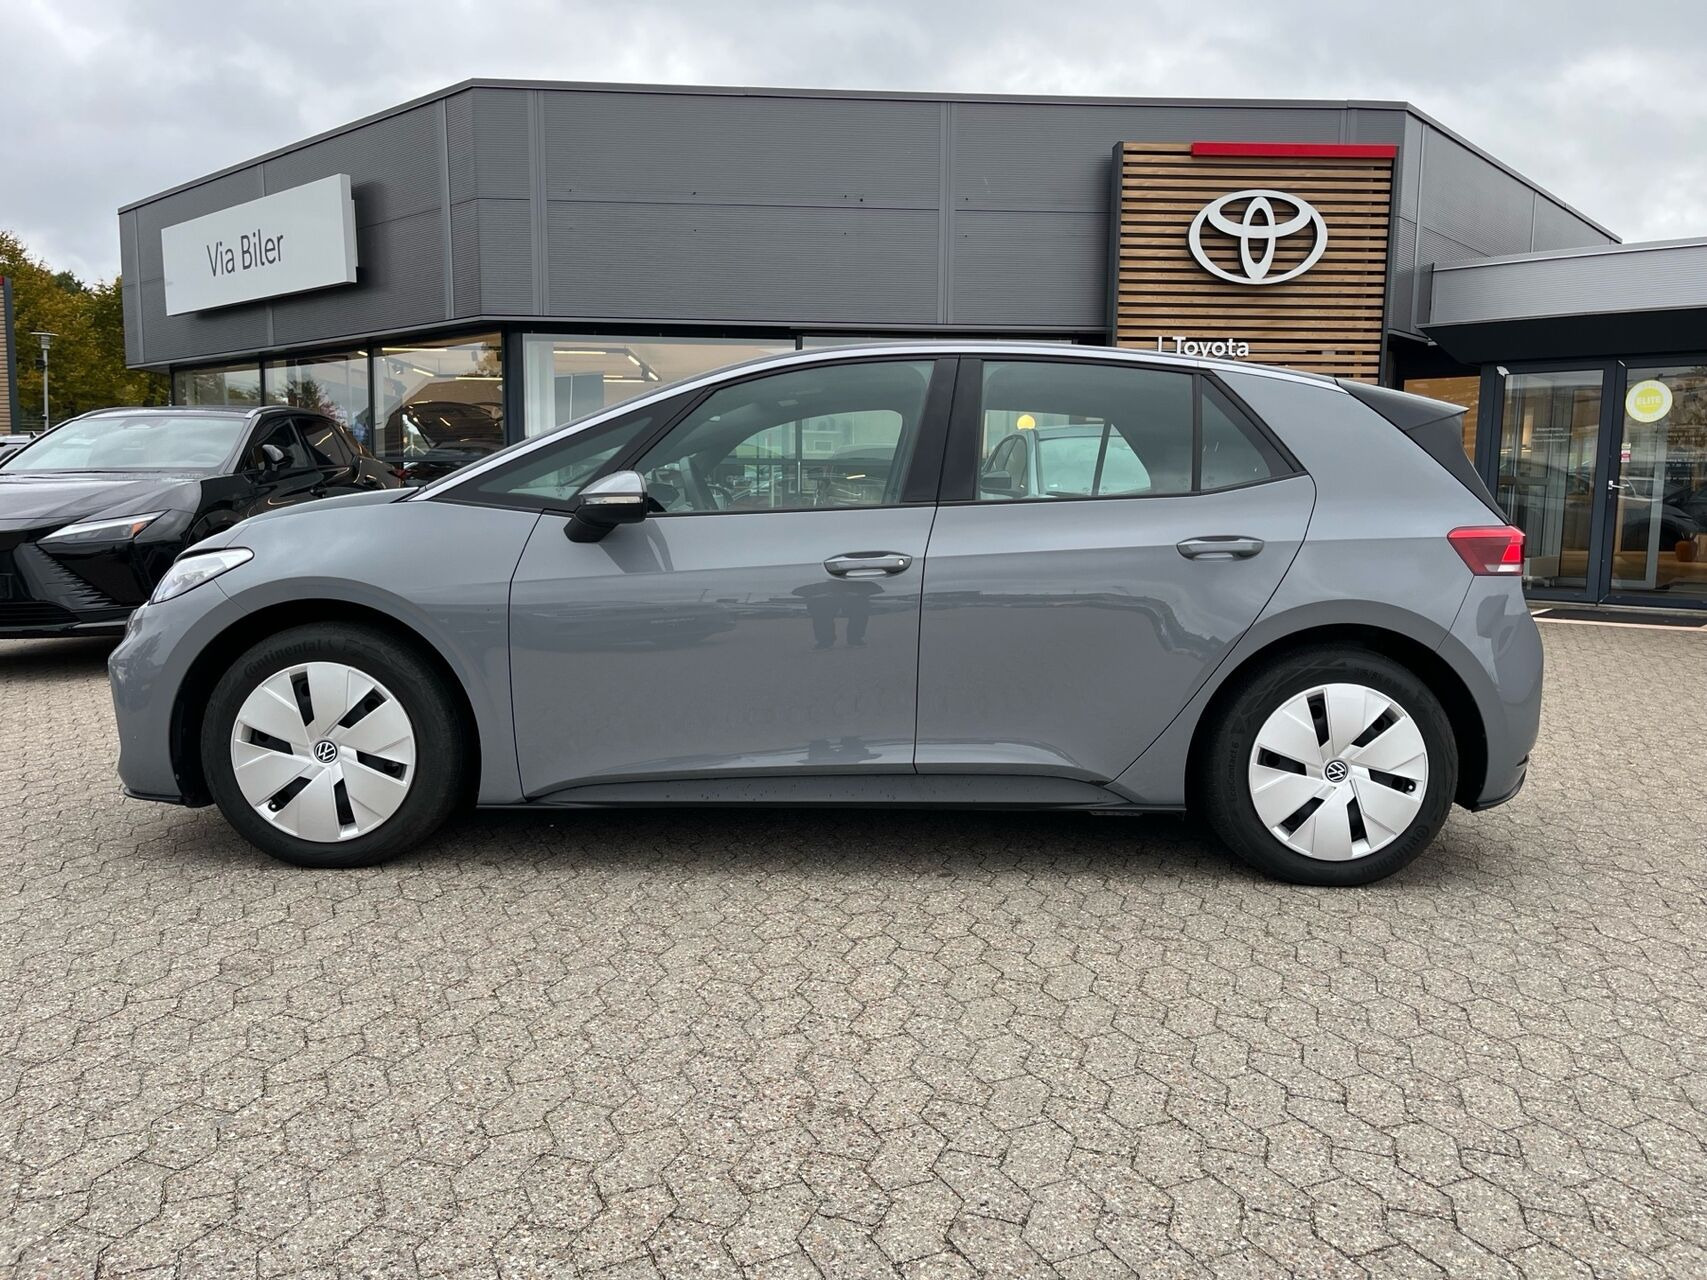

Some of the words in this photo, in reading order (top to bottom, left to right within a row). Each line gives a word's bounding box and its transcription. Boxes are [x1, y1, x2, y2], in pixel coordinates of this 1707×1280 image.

[206, 240, 236, 277] Via
[240, 228, 284, 270] Biler
[1172, 336, 1250, 358] Toyota
[244, 639, 322, 678] Continental
